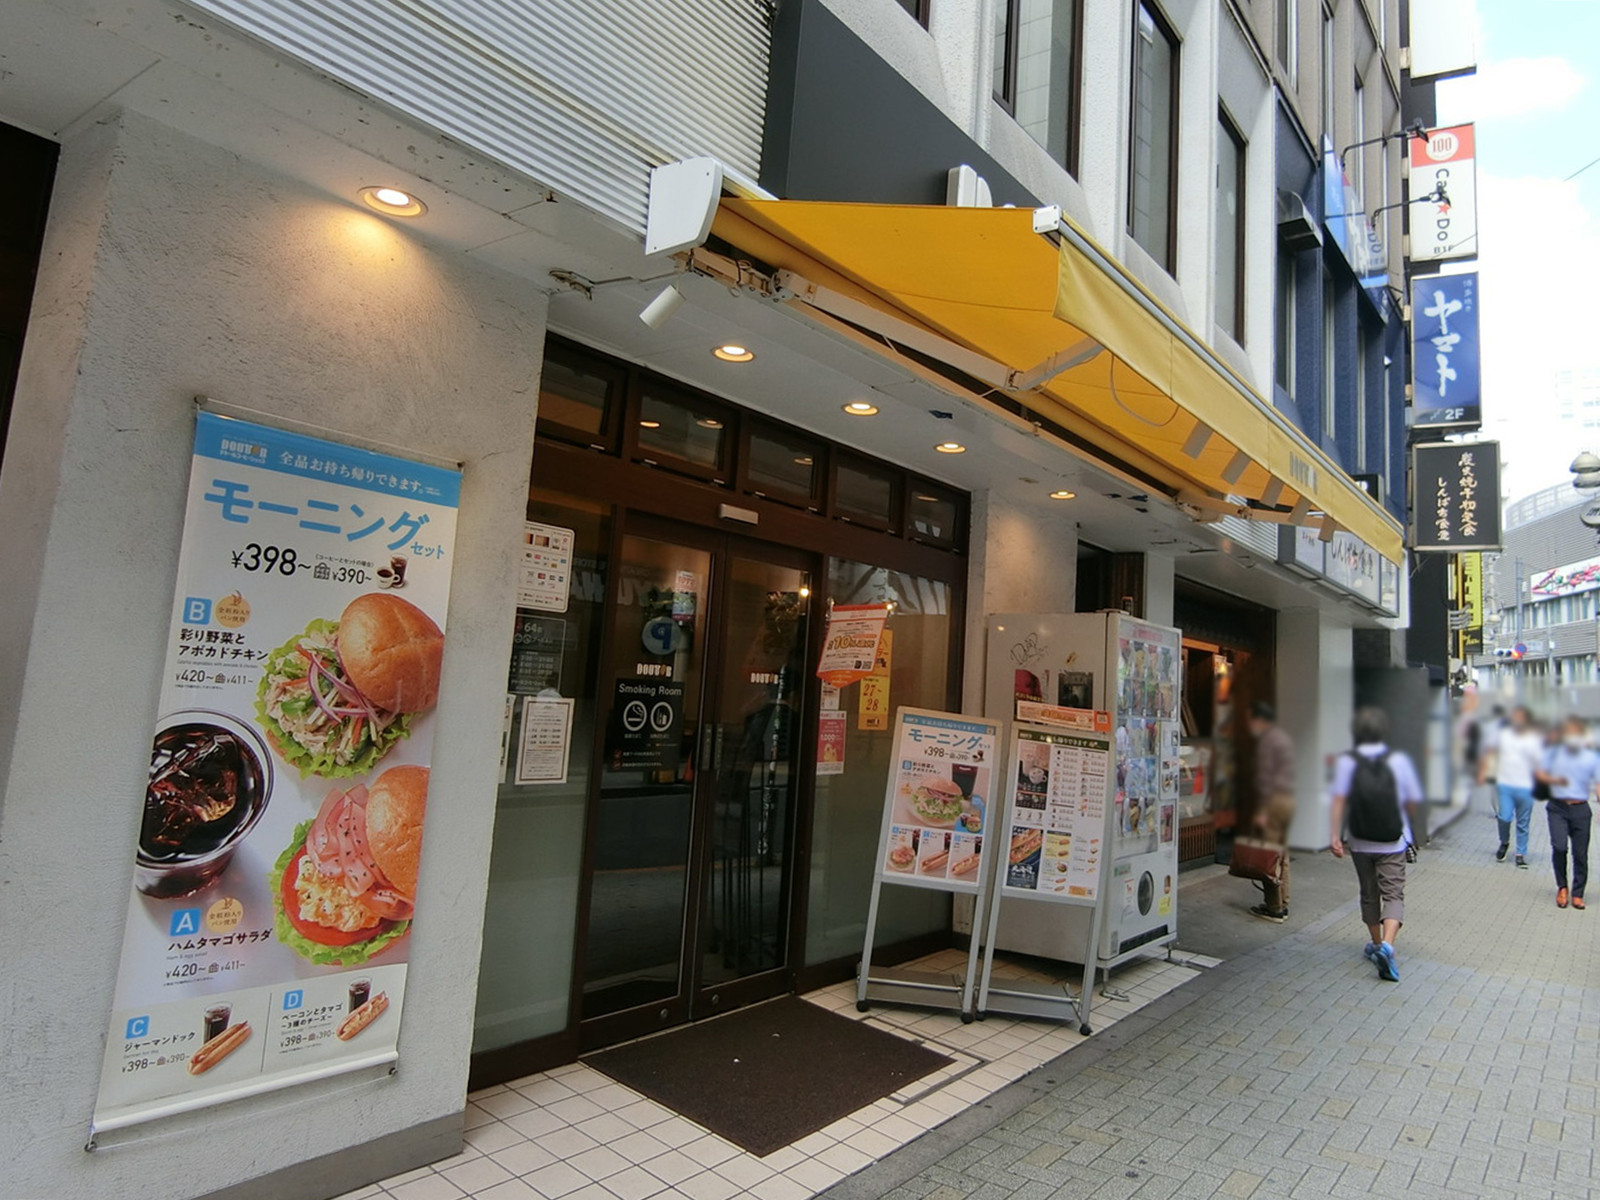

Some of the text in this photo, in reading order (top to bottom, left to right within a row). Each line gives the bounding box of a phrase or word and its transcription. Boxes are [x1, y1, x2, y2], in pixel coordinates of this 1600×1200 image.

[1432, 137, 1452, 153] 100
[1424, 289, 1462, 397] ヤマト
[1444, 407, 1464, 420] 2F
[280, 451, 424, 494] 全品お持ち帰りできます。
[204, 479, 445, 560] モーニング セット
[189, 601, 206, 621] B
[180, 628, 246, 645] 彩り野菜と
[178, 644, 269, 661] アボカドチキン
[636, 663, 672, 677] DOUTOR
[618, 682, 682, 697] Smoking Room
[908, 728, 982, 750] モーニング
[175, 912, 194, 933] A
[168, 928, 273, 951] ハムタマゴサラダ
[287, 993, 299, 1008] D
[282, 1002, 343, 1020] ベーコンとタマゴ
[131, 1019, 145, 1035] C
